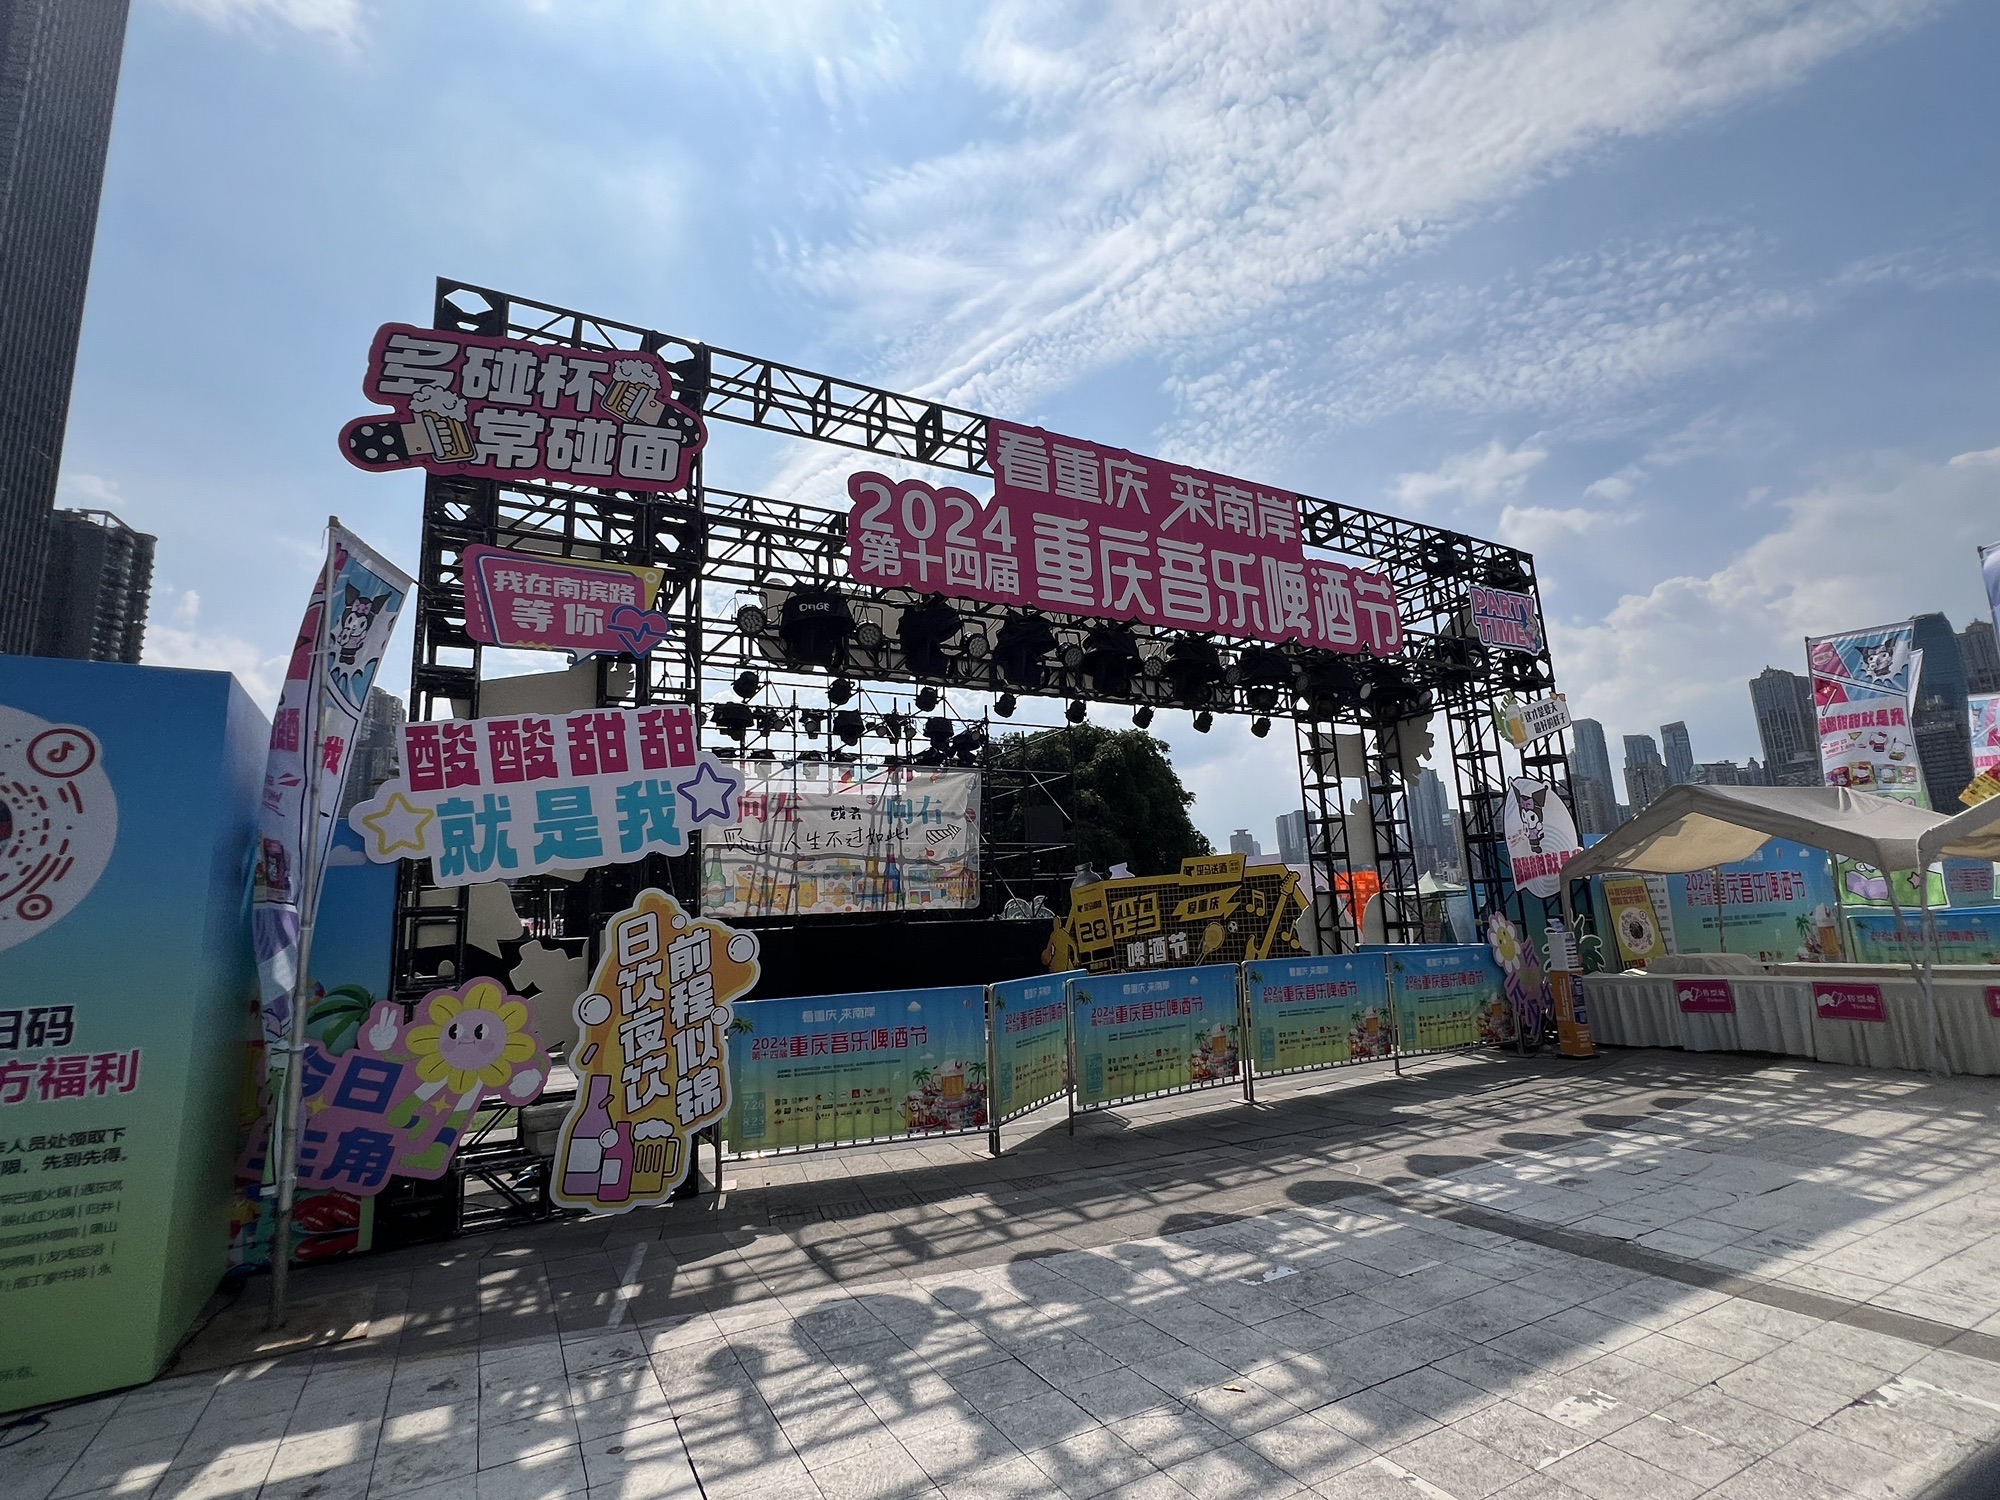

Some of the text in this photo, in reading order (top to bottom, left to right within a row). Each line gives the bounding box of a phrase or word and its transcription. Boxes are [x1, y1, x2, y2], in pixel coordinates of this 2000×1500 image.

[379, 334, 609, 412] 多碰杯
[473, 408, 681, 481] 常碰面
[996, 429, 1297, 544] 看重庆 来南岸
[859, 481, 1017, 552] 2024
[493, 569, 636, 605] 我在南滨路
[859, 531, 1020, 596] 第十四届
[1032, 511, 1399, 650] 重庆音乐啤酒节
[510, 599, 605, 637] 等你
[1472, 586, 1535, 620] PARTY
[1476, 616, 1528, 648] TIME
[405, 708, 697, 792] 酸酸甜甜
[437, 779, 681, 877] 就是我
[736, 790, 804, 825] 向左
[886, 794, 944, 825] 向右
[1080, 919, 1107, 943] 28
[1187, 897, 1219, 915] 爱重庆
[1127, 932, 1188, 968] 啤酒节
[615, 912, 670, 1114] 日饮夜饮
[667, 928, 721, 1124] 前程似锦
[751, 1036, 787, 1050] 2024
[789, 1025, 928, 1058] 重庆音乐啤酒节
